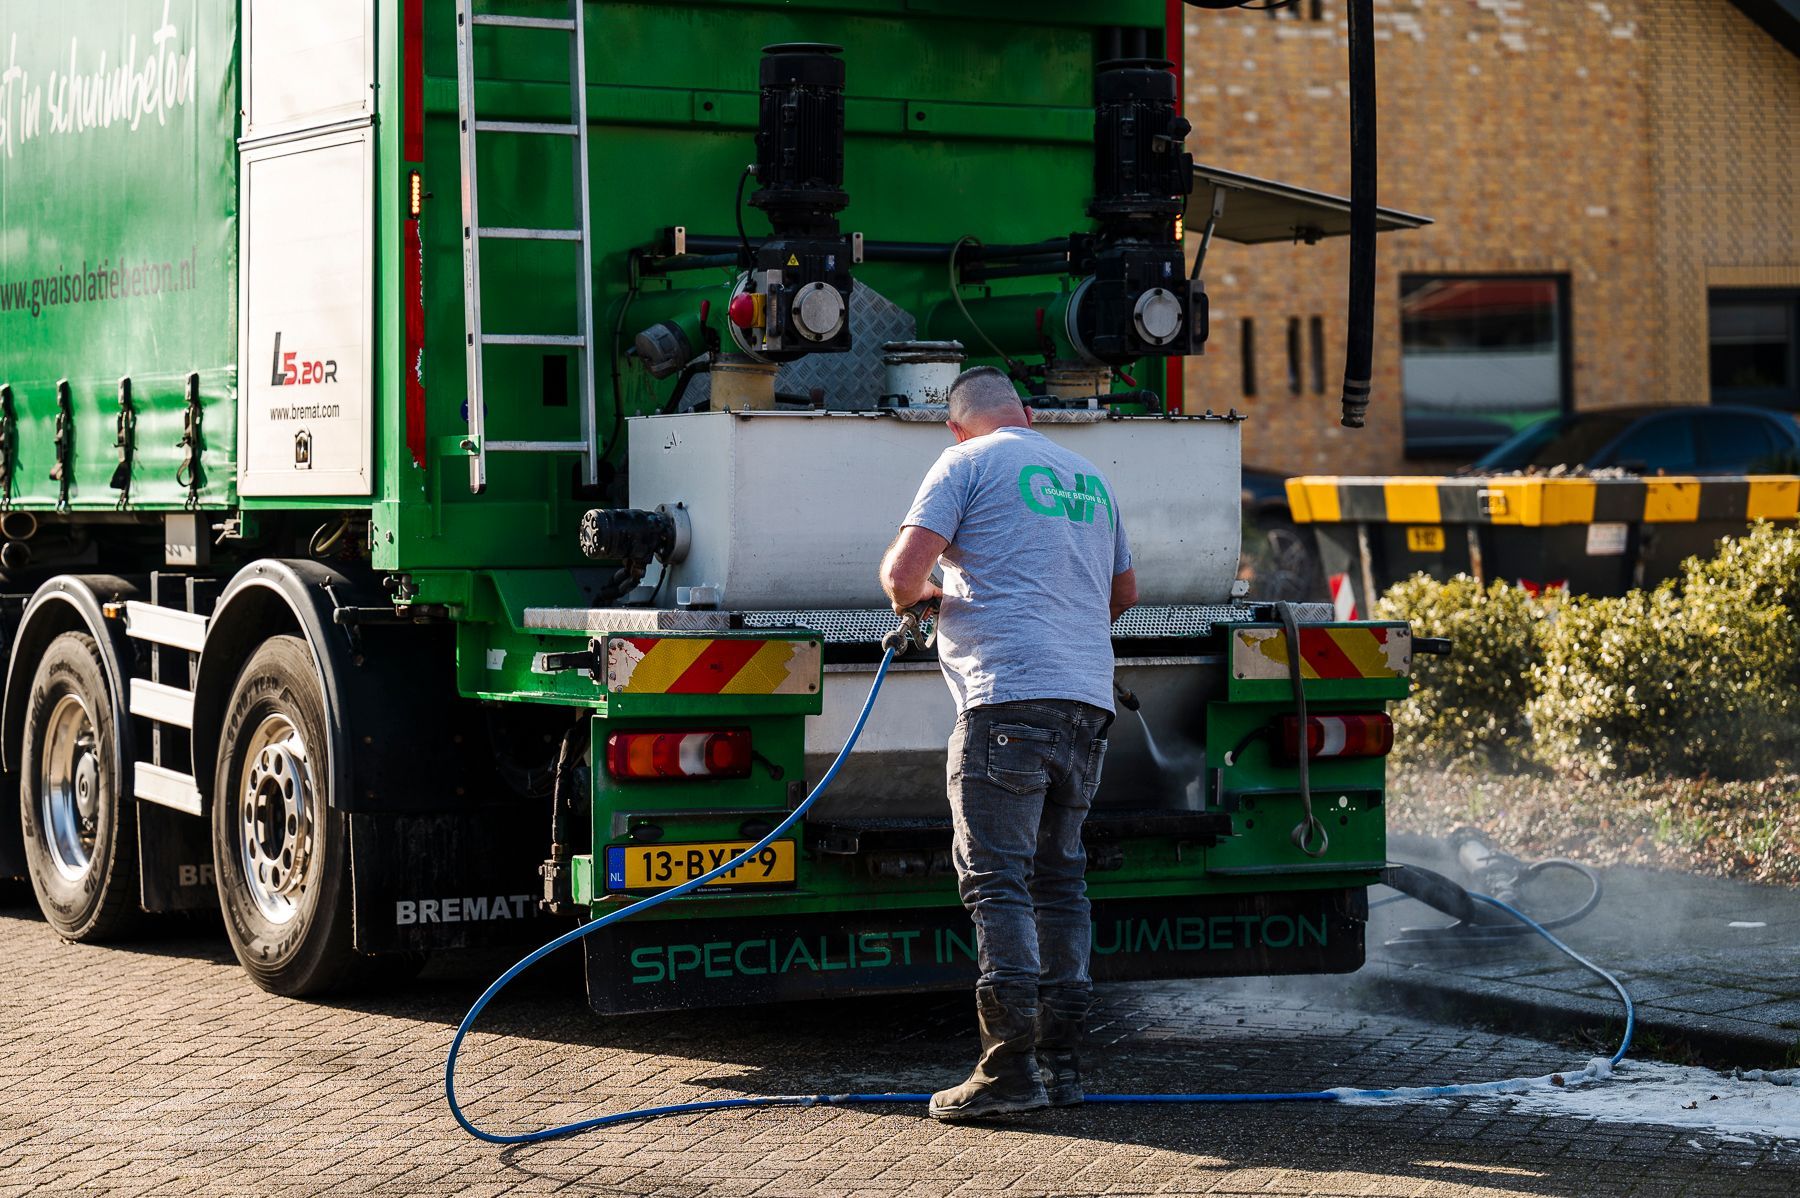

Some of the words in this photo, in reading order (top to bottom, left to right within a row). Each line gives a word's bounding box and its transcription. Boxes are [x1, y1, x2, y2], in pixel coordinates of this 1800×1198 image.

[20, 70, 41, 144] in
[270, 402, 340, 421] www.bremat.com
[1073, 492, 1096, 502] BETON
[610, 871, 623, 882] NL
[643, 846, 777, 882] 13-BXF-9
[630, 931, 921, 984] SPECIALIST
[935, 926, 977, 964] IN
[1092, 913, 1327, 955] UIMBETON
